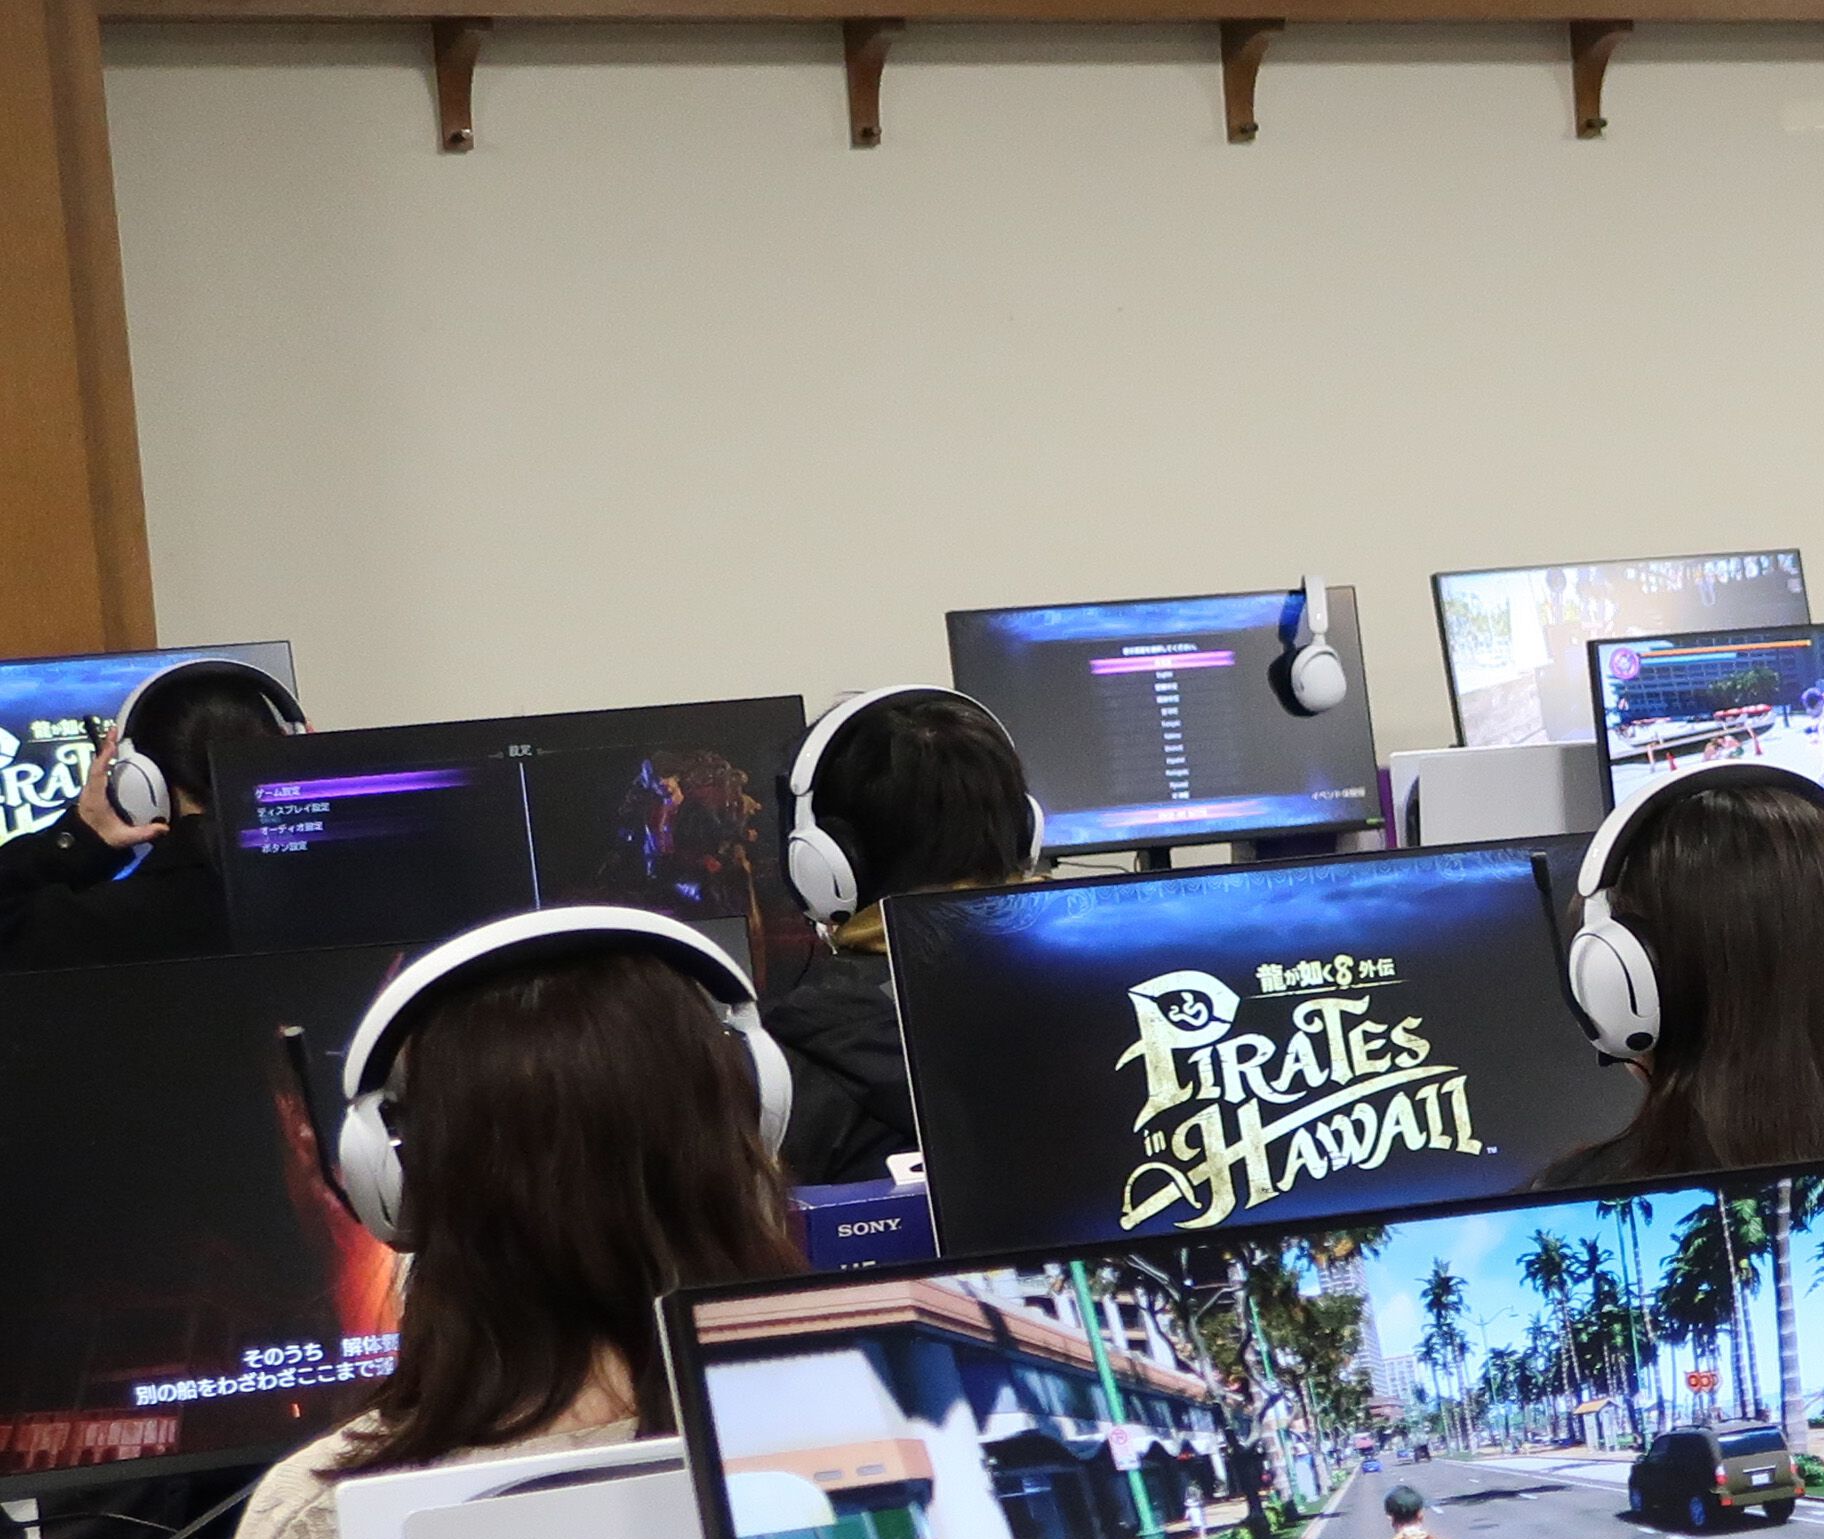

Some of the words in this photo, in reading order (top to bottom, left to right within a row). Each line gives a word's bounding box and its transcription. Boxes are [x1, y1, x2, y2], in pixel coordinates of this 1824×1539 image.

[1116, 970, 1431, 1133] PIRATES
[1119, 1068, 1483, 1230] HAWAII
[1144, 1129, 1166, 1157] in
[838, 1218, 901, 1238] SONY
[243, 1341, 324, 1369] そのうち
